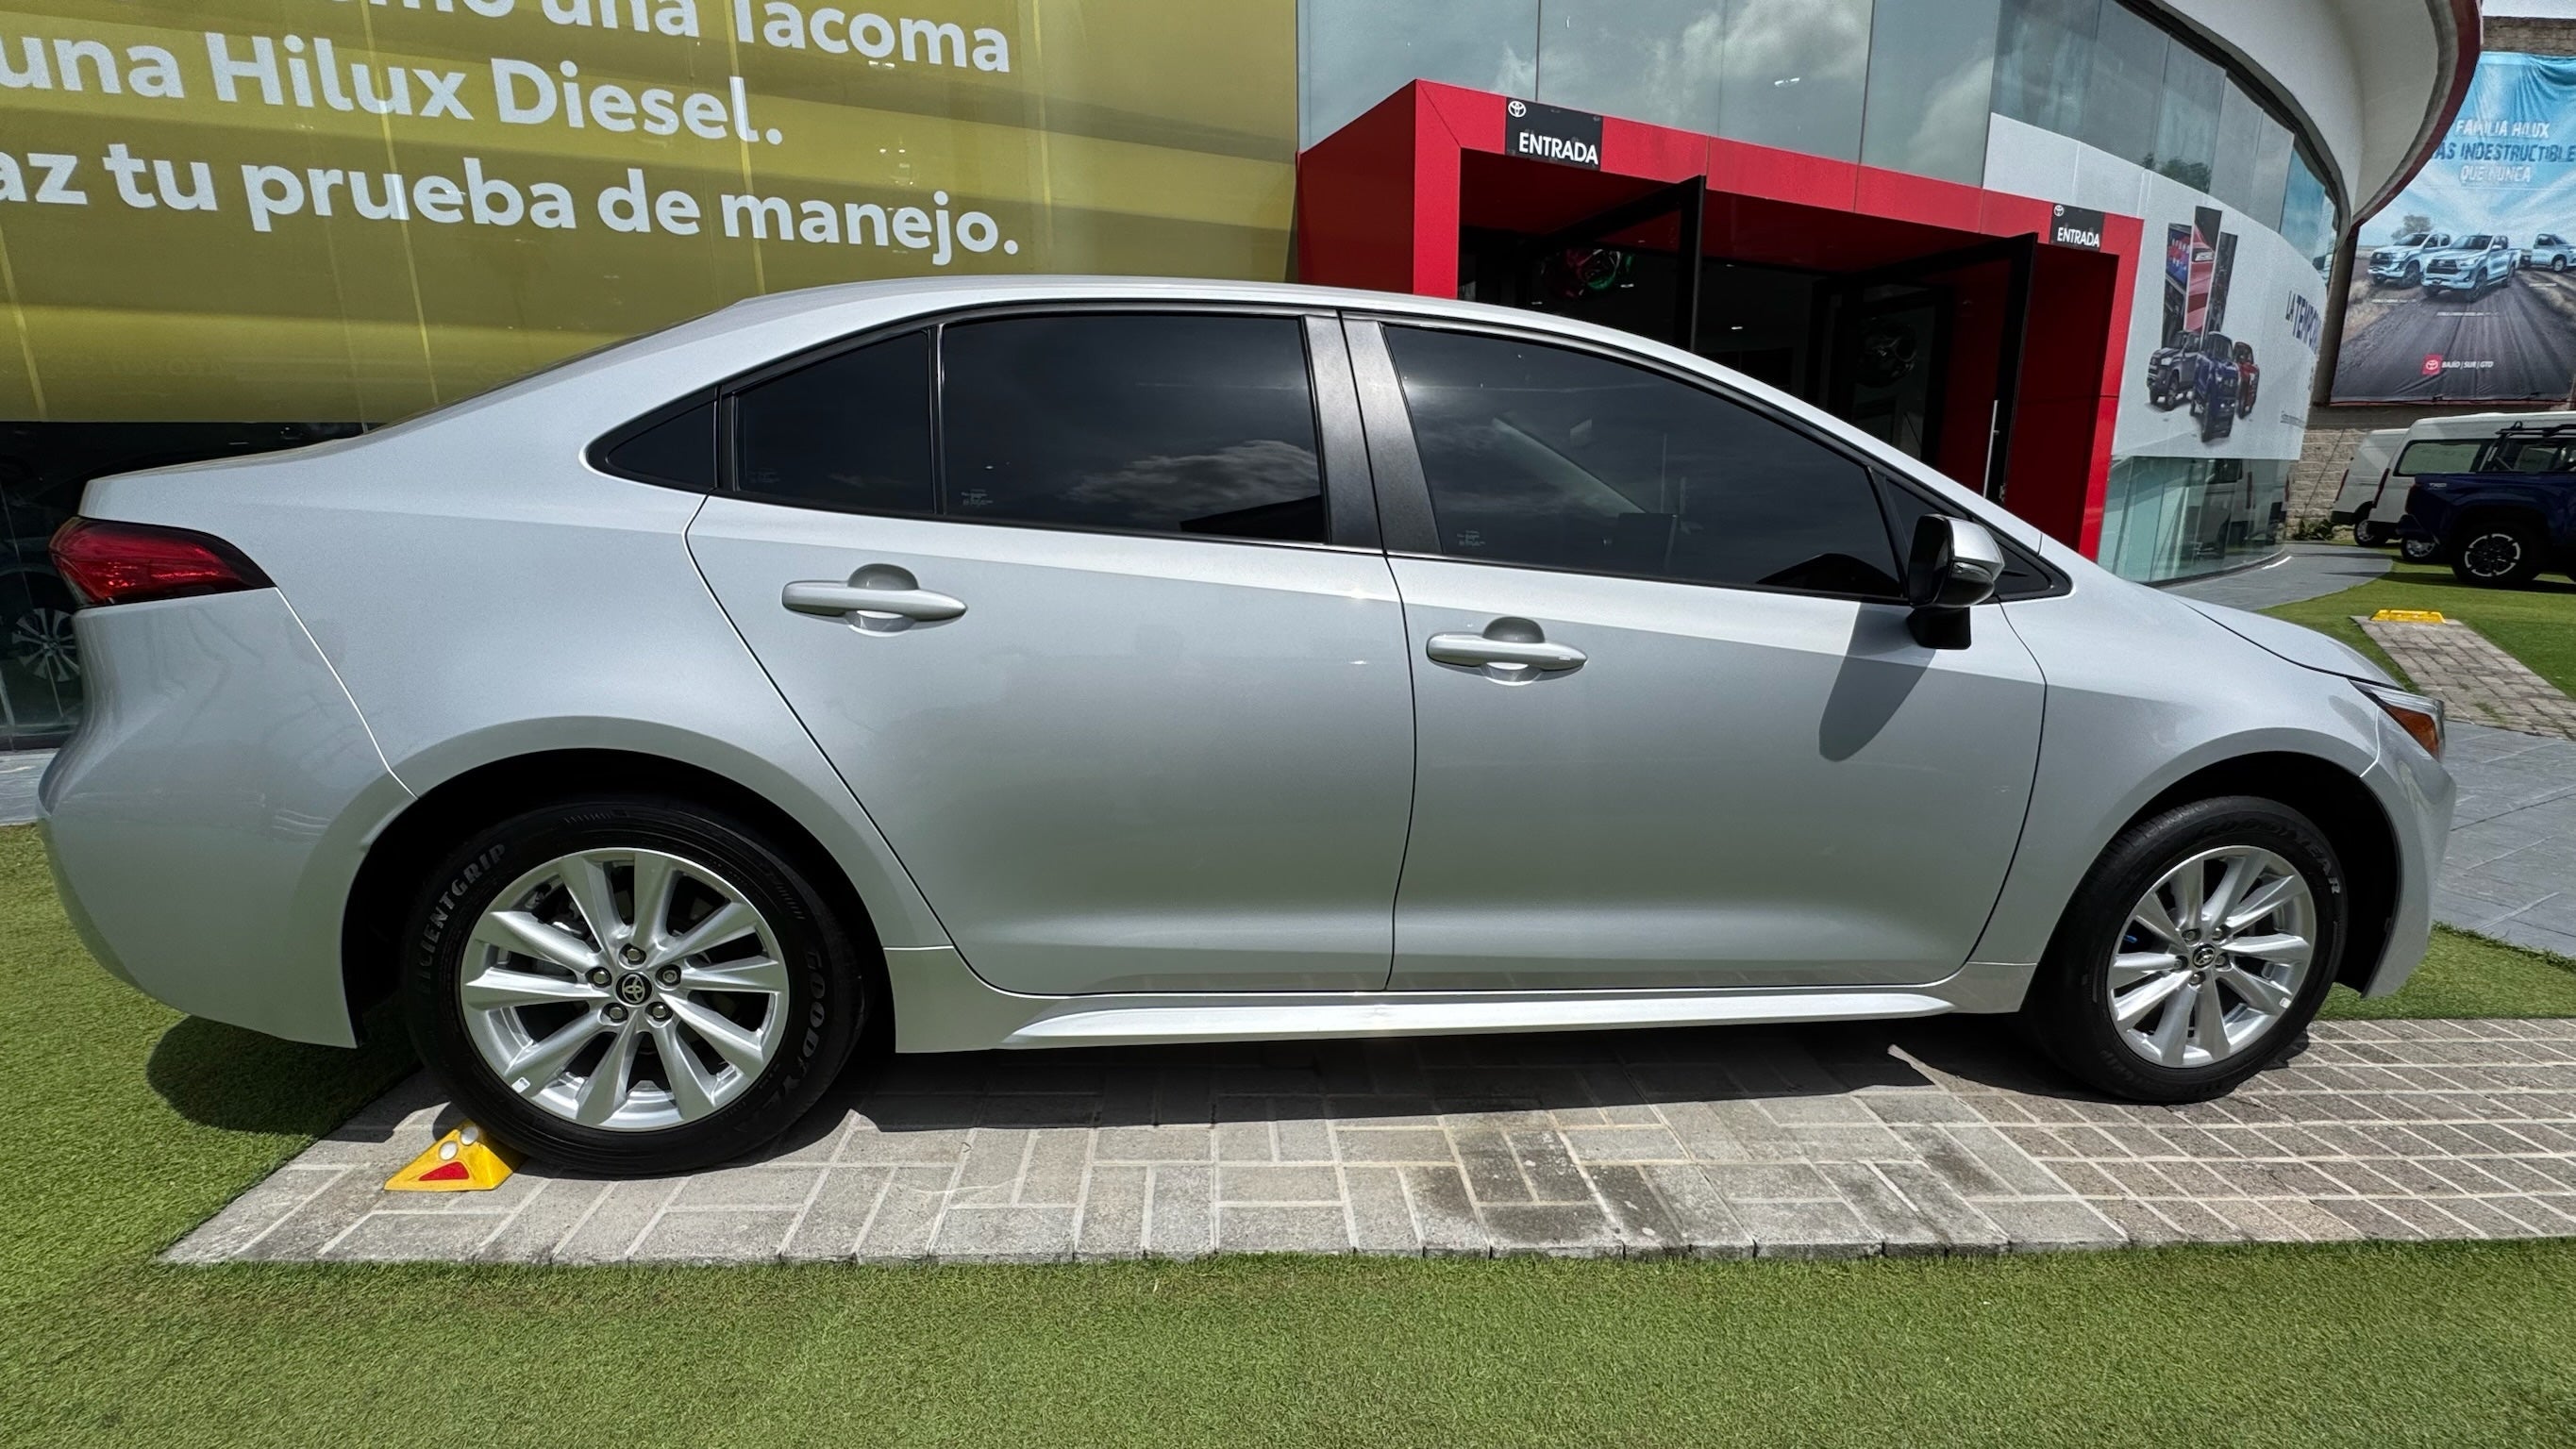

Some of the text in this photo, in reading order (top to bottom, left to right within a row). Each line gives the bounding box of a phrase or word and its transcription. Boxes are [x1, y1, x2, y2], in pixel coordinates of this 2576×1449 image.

[0, 33, 781, 144] una Hilux Diesel.
[2454, 119, 2551, 139] FAMILIA HILUX
[1518, 131, 1598, 165] ENTRADA
[2460, 164, 2485, 182] QUE
[105, 143, 217, 211] tu
[243, 158, 577, 232] prueba
[597, 168, 700, 235] de
[720, 192, 1018, 265] manejo.
[2056, 226, 2100, 248] ENTRADA
